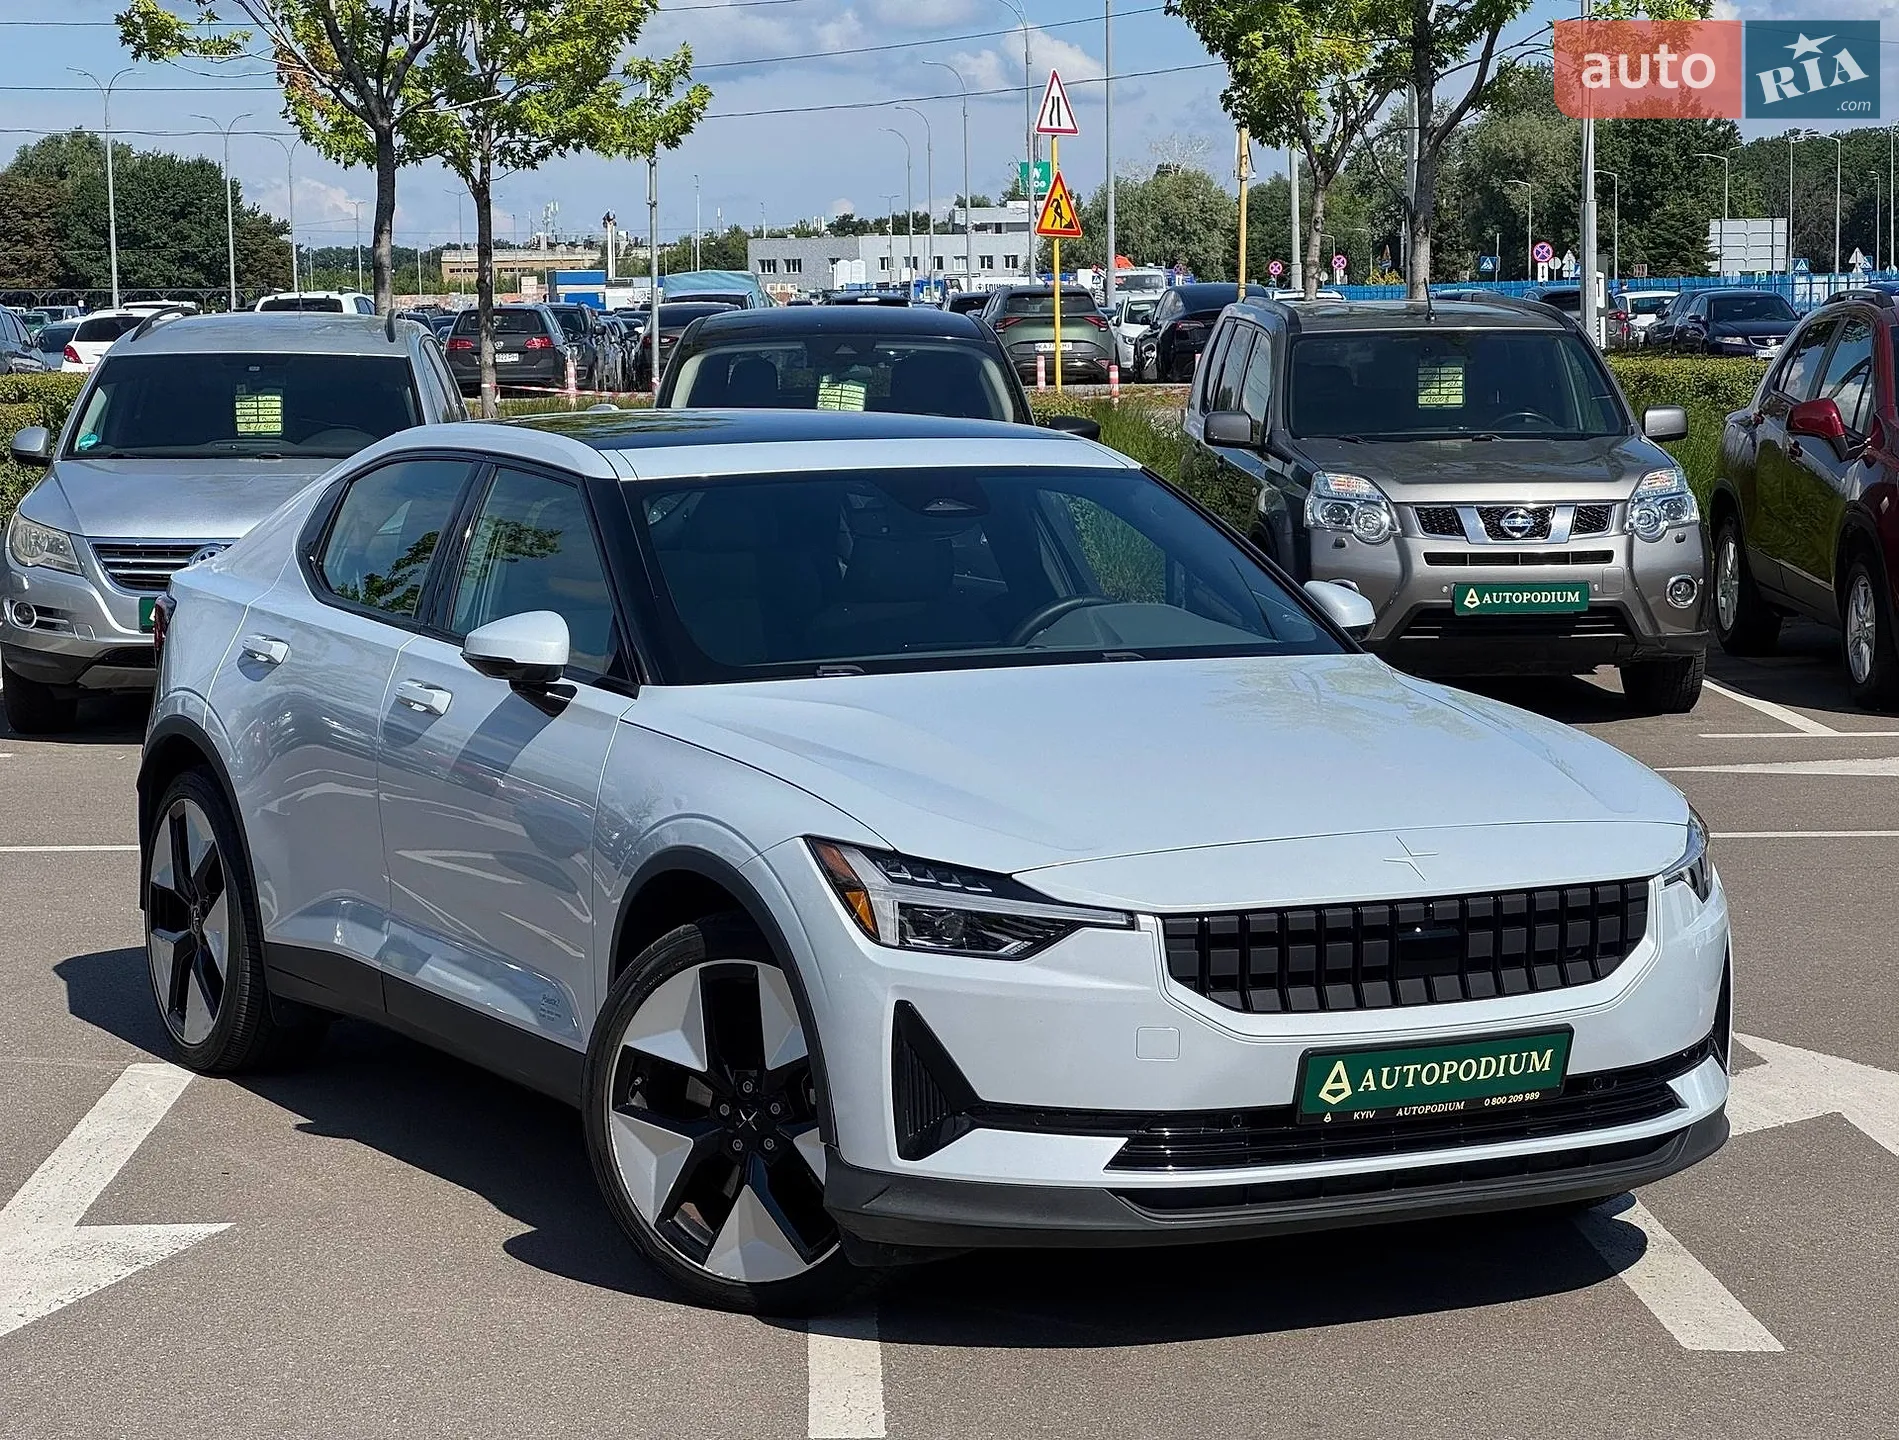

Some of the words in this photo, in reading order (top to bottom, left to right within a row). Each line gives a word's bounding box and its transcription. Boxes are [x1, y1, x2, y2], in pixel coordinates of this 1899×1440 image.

[1482, 591, 1580, 604] AUTOPODIUM
[1358, 1049, 1554, 1092] AUTOPODIUM
[1353, 1110, 1376, 1121] KYIV
[1396, 1102, 1465, 1116] AUTOPODIUM
[1490, 1096, 1507, 1106] 800
[1508, 1094, 1523, 1104] 209
[1524, 1091, 1540, 1102] 989
